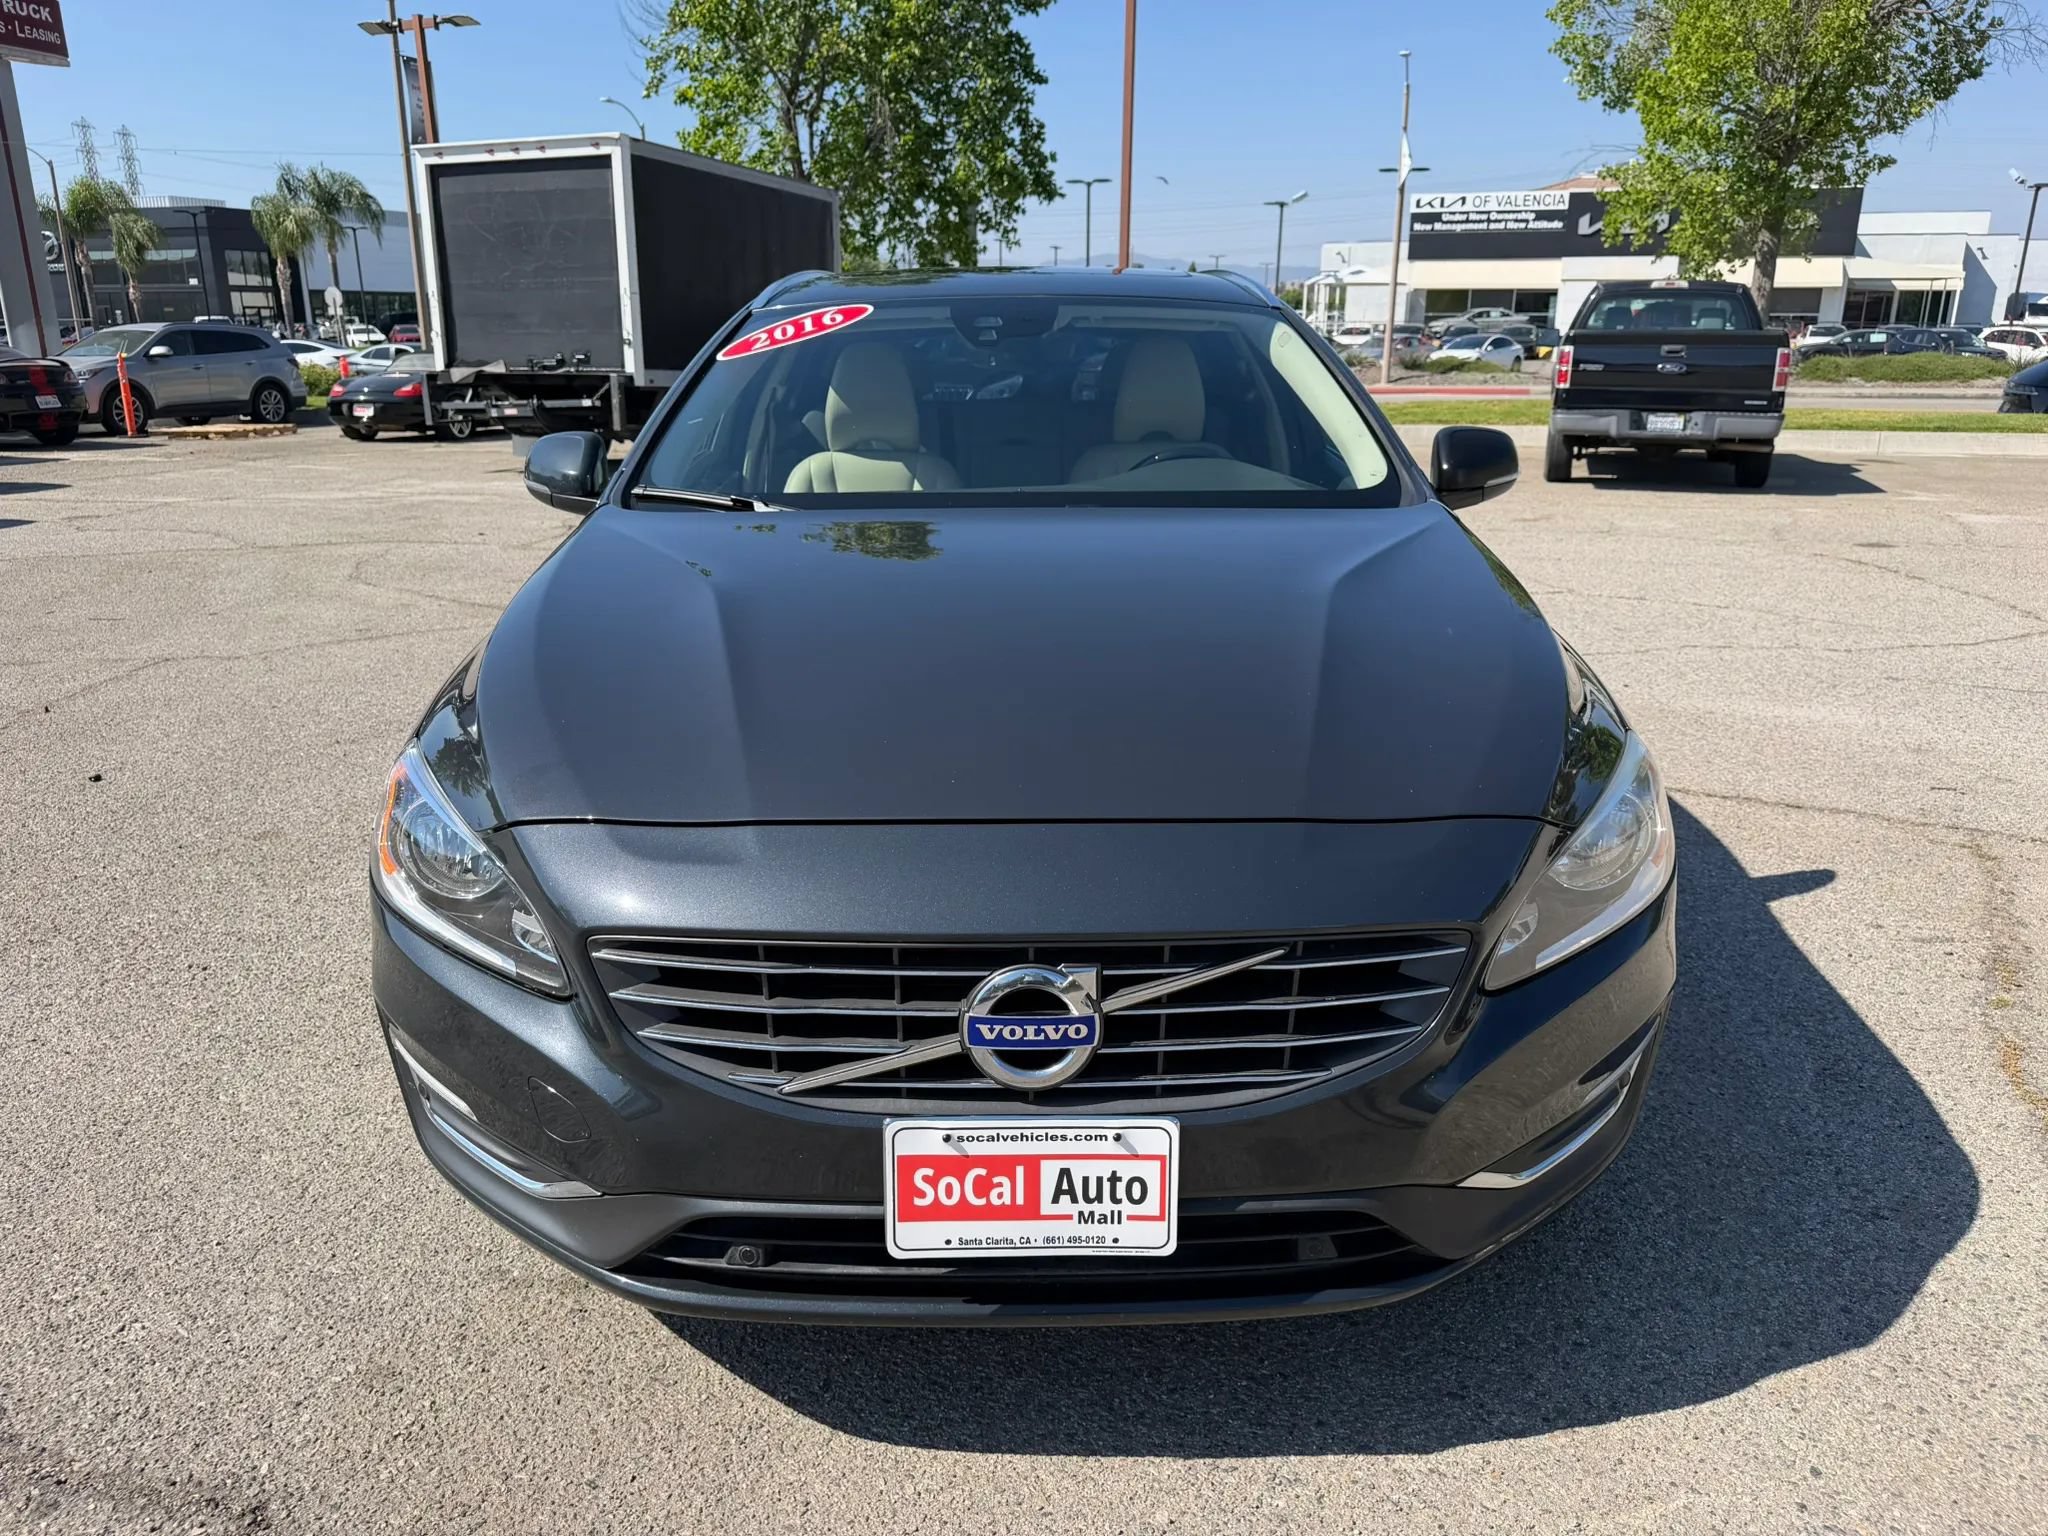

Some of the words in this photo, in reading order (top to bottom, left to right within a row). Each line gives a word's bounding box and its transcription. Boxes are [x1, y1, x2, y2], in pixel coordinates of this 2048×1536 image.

[15, 20, 61, 44] LEASING
[1416, 196, 1467, 208] KIA
[1472, 195, 1491, 208] OF
[1496, 193, 1566, 207] VALENCIA
[1441, 212, 1468, 222] Under
[1468, 212, 1488, 221] New
[1489, 211, 1536, 221] Ownership
[1413, 222, 1433, 231] New
[1433, 221, 1488, 232] Management
[1488, 221, 1506, 230] and
[1506, 220, 1527, 230] New
[1527, 219, 1564, 229] Attitude
[749, 309, 844, 351] 2016
[975, 1024, 1088, 1040] VOLVO
[956, 1131, 1108, 1143] socalvehicles.com
[913, 1165, 1025, 1206] SoCal
[1050, 1167, 1149, 1205] Auto
[1077, 1210, 1122, 1225] Mall
[958, 1236, 982, 1246] Santa
[985, 1235, 1017, 1247] Clarita,
[1019, 1235, 1032, 1246] CA
[1042, 1235, 1065, 1246] (661)
[1067, 1235, 1106, 1245] 495-0120
